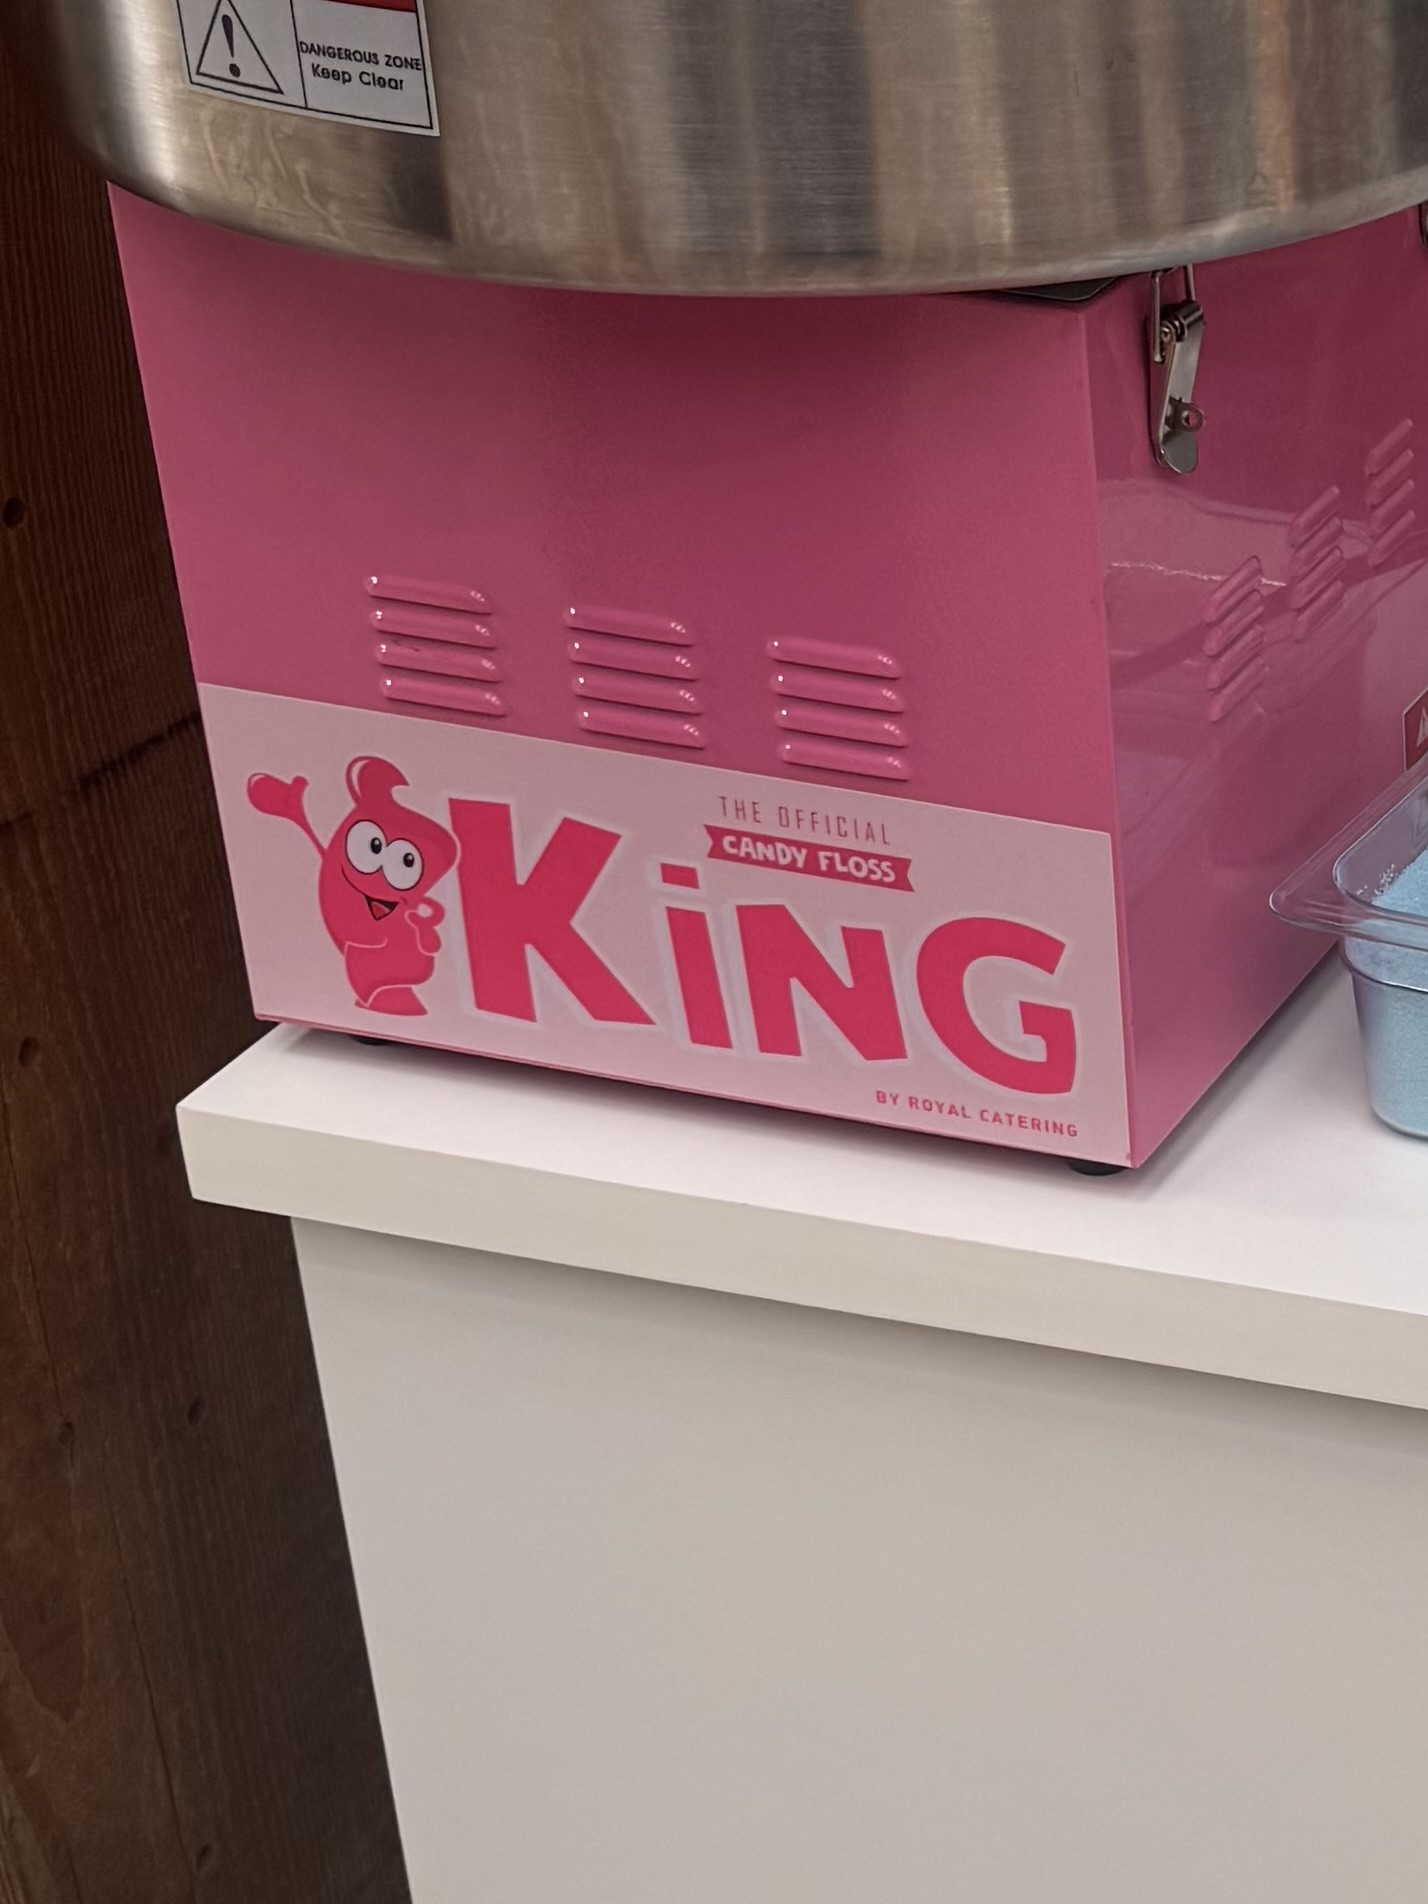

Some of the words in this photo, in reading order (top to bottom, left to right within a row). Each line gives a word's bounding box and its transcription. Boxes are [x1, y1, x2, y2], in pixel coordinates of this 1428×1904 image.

[299, 41, 380, 65] DANGEROUS
[384, 54, 423, 71] ZONE
[311, 62, 352, 85] Keep
[358, 71, 404, 91] Clear
[719, 796, 763, 824] THE
[778, 806, 891, 845] OFFICIAL
[722, 835, 808, 869] CANDY
[818, 851, 897, 883] FLOSS
[875, 1090, 900, 1106] BY
[908, 1096, 972, 1119] ROYAL
[979, 1109, 1079, 1138] CATERING
